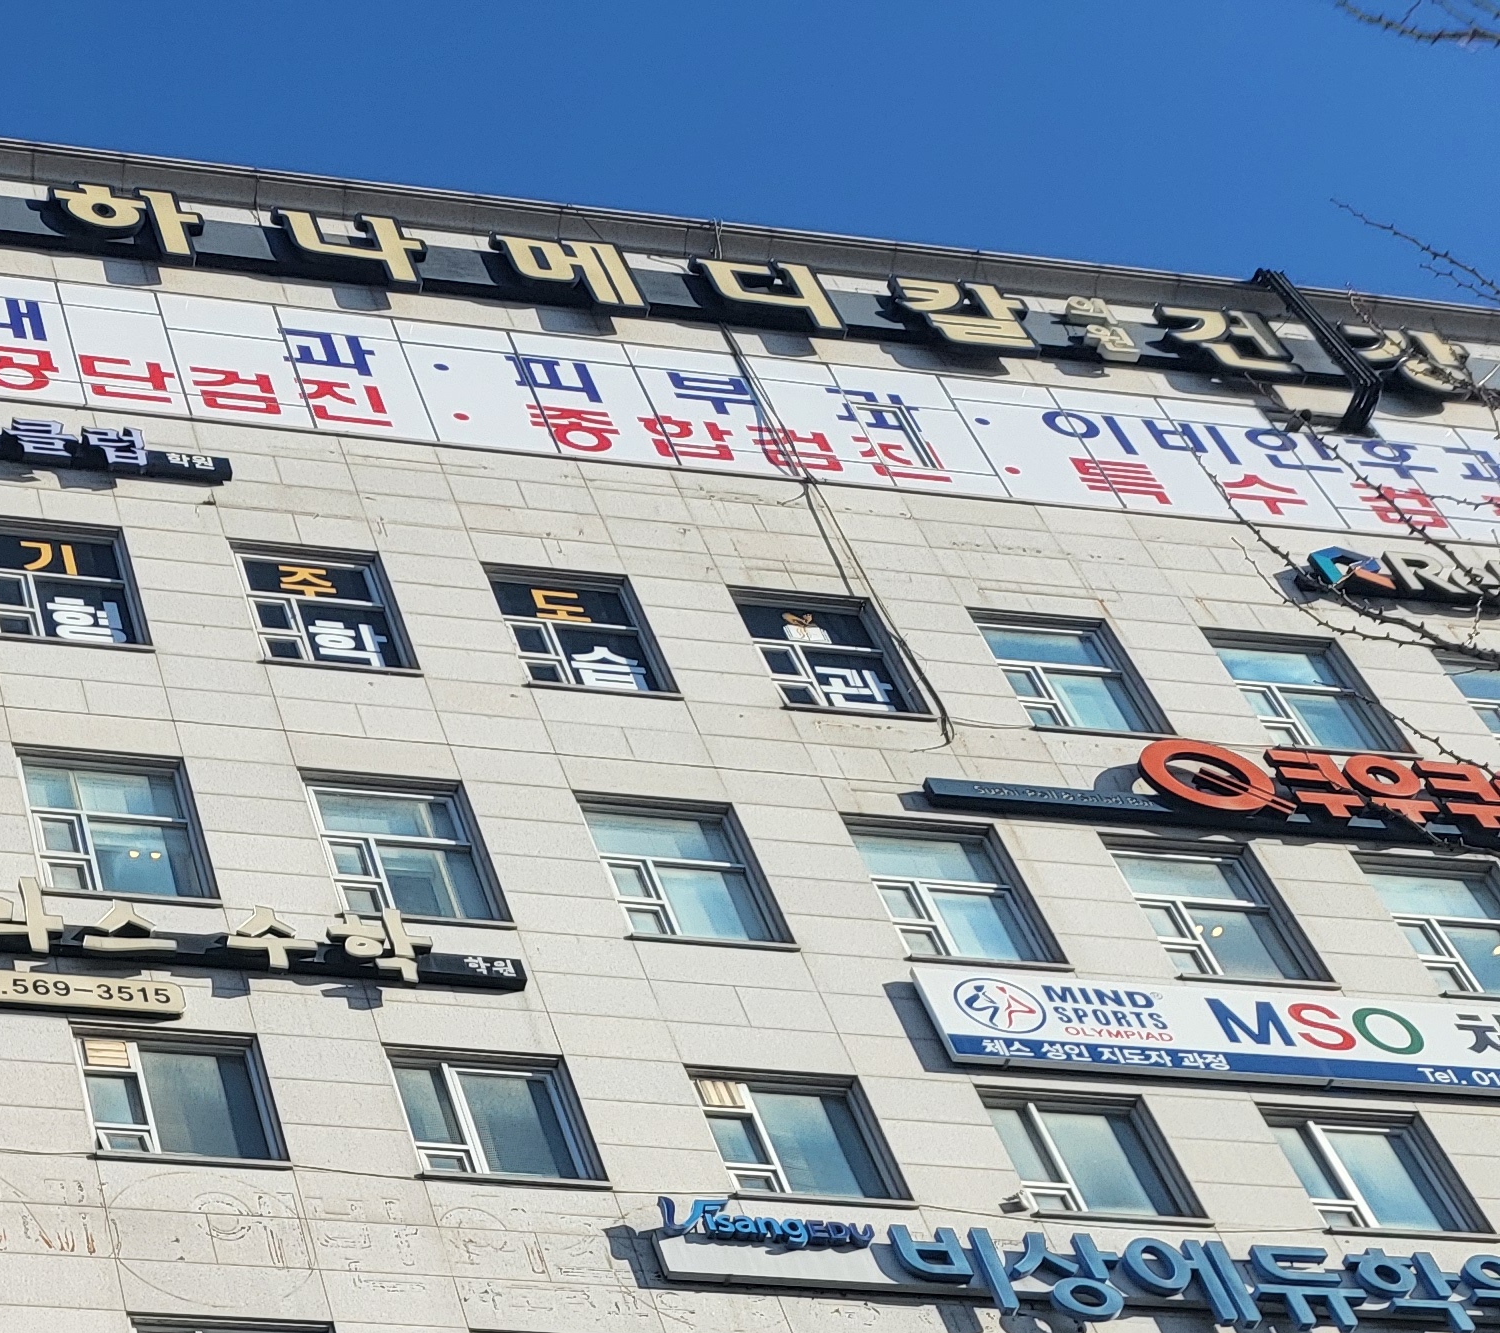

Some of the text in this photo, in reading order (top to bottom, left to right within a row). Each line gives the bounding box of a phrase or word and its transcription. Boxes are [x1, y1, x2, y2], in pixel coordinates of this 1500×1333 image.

[1064, 295, 1142, 363] 의원
[525, 403, 952, 483] 종합검진
[164, 451, 217, 472] 학원
[1264, 747, 1500, 830] 쿠우쿠
[227, 903, 434, 984] 수학
[462, 955, 517, 979] 학원
[1040, 983, 1156, 1010] MIND
[1053, 1005, 1169, 1032] SPORTS
[1063, 1025, 1175, 1043] OLYMPIAD
[1203, 995, 1425, 1056] MSO
[981, 1037, 1232, 1073] 체스 성인 지도자 과정
[1416, 1067, 1468, 1085] Tel.
